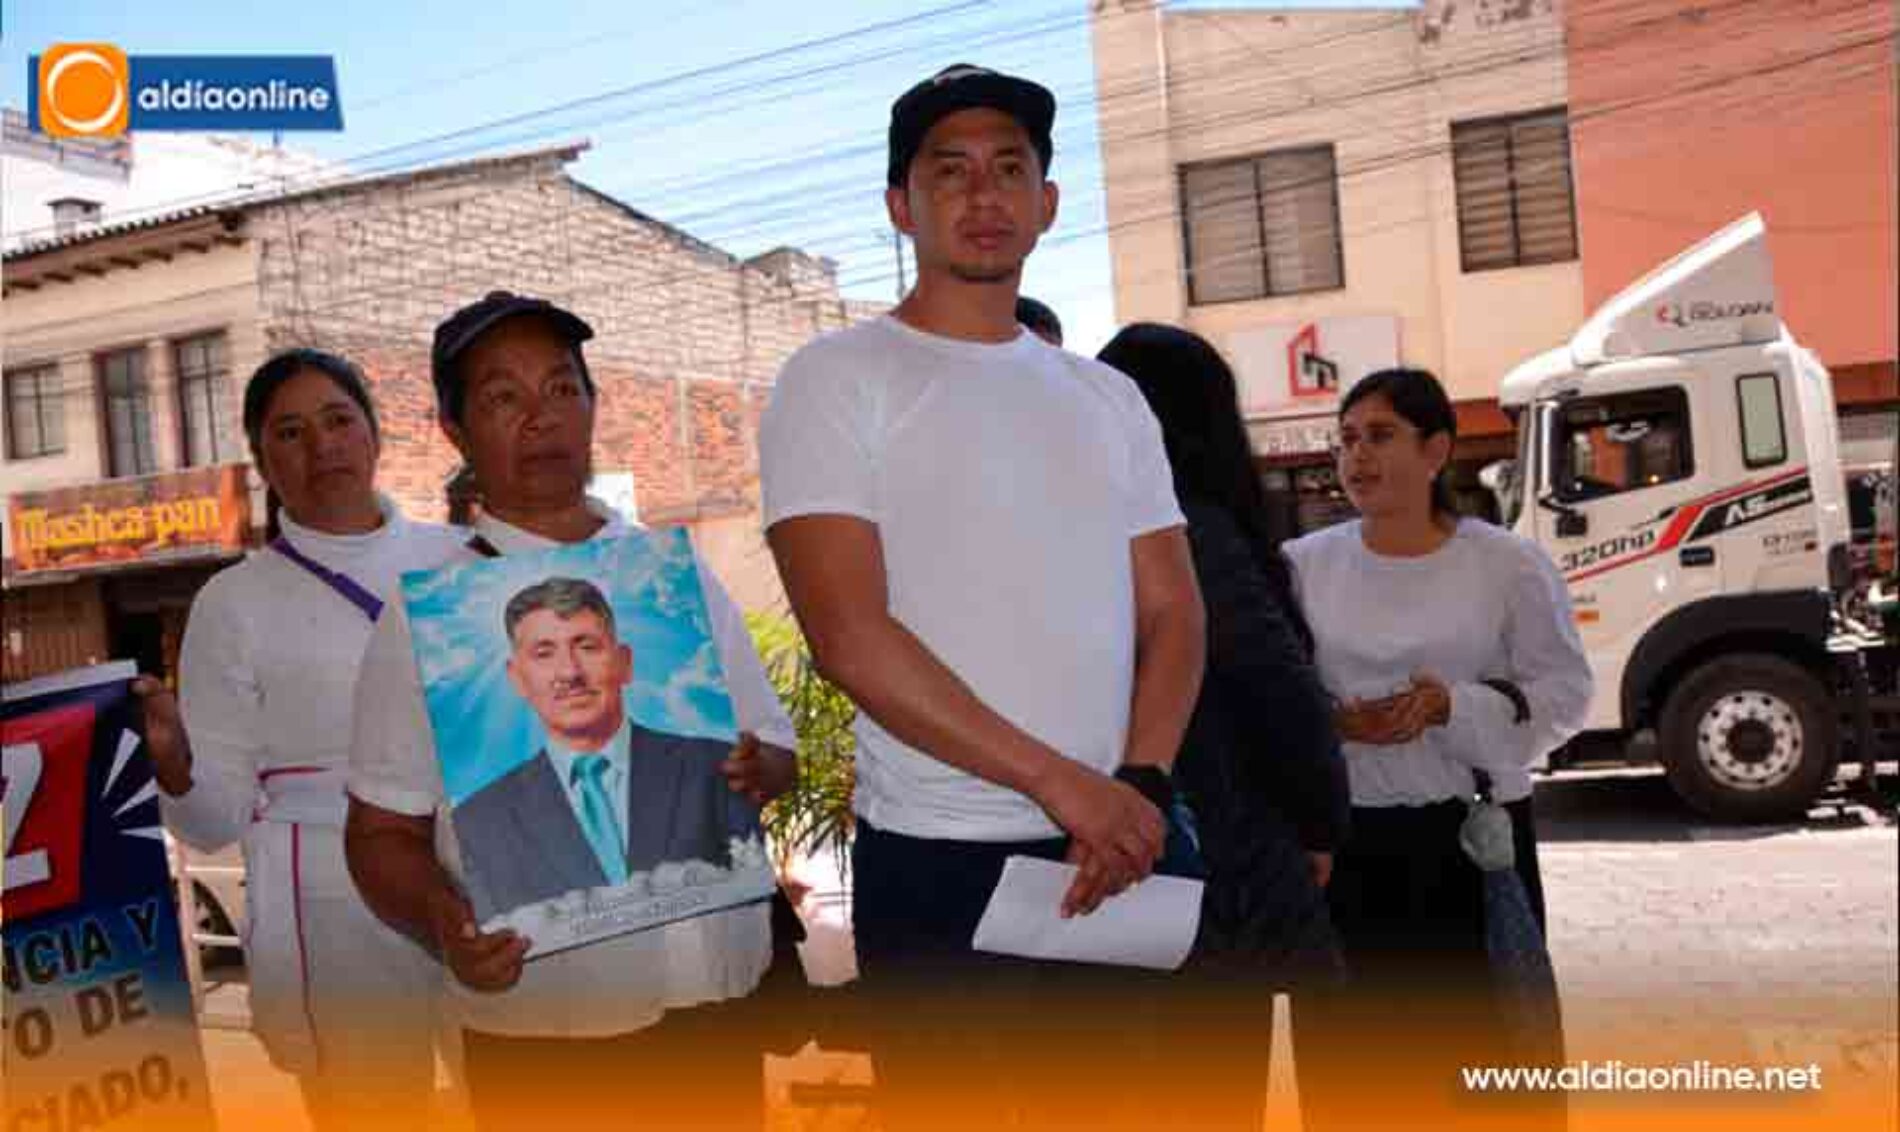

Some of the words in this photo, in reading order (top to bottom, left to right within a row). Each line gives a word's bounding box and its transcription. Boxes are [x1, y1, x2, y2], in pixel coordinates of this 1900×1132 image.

[1560, 529, 1656, 571] 320hp
[123, 898, 159, 951] Y
[74, 971, 147, 1037] DE
